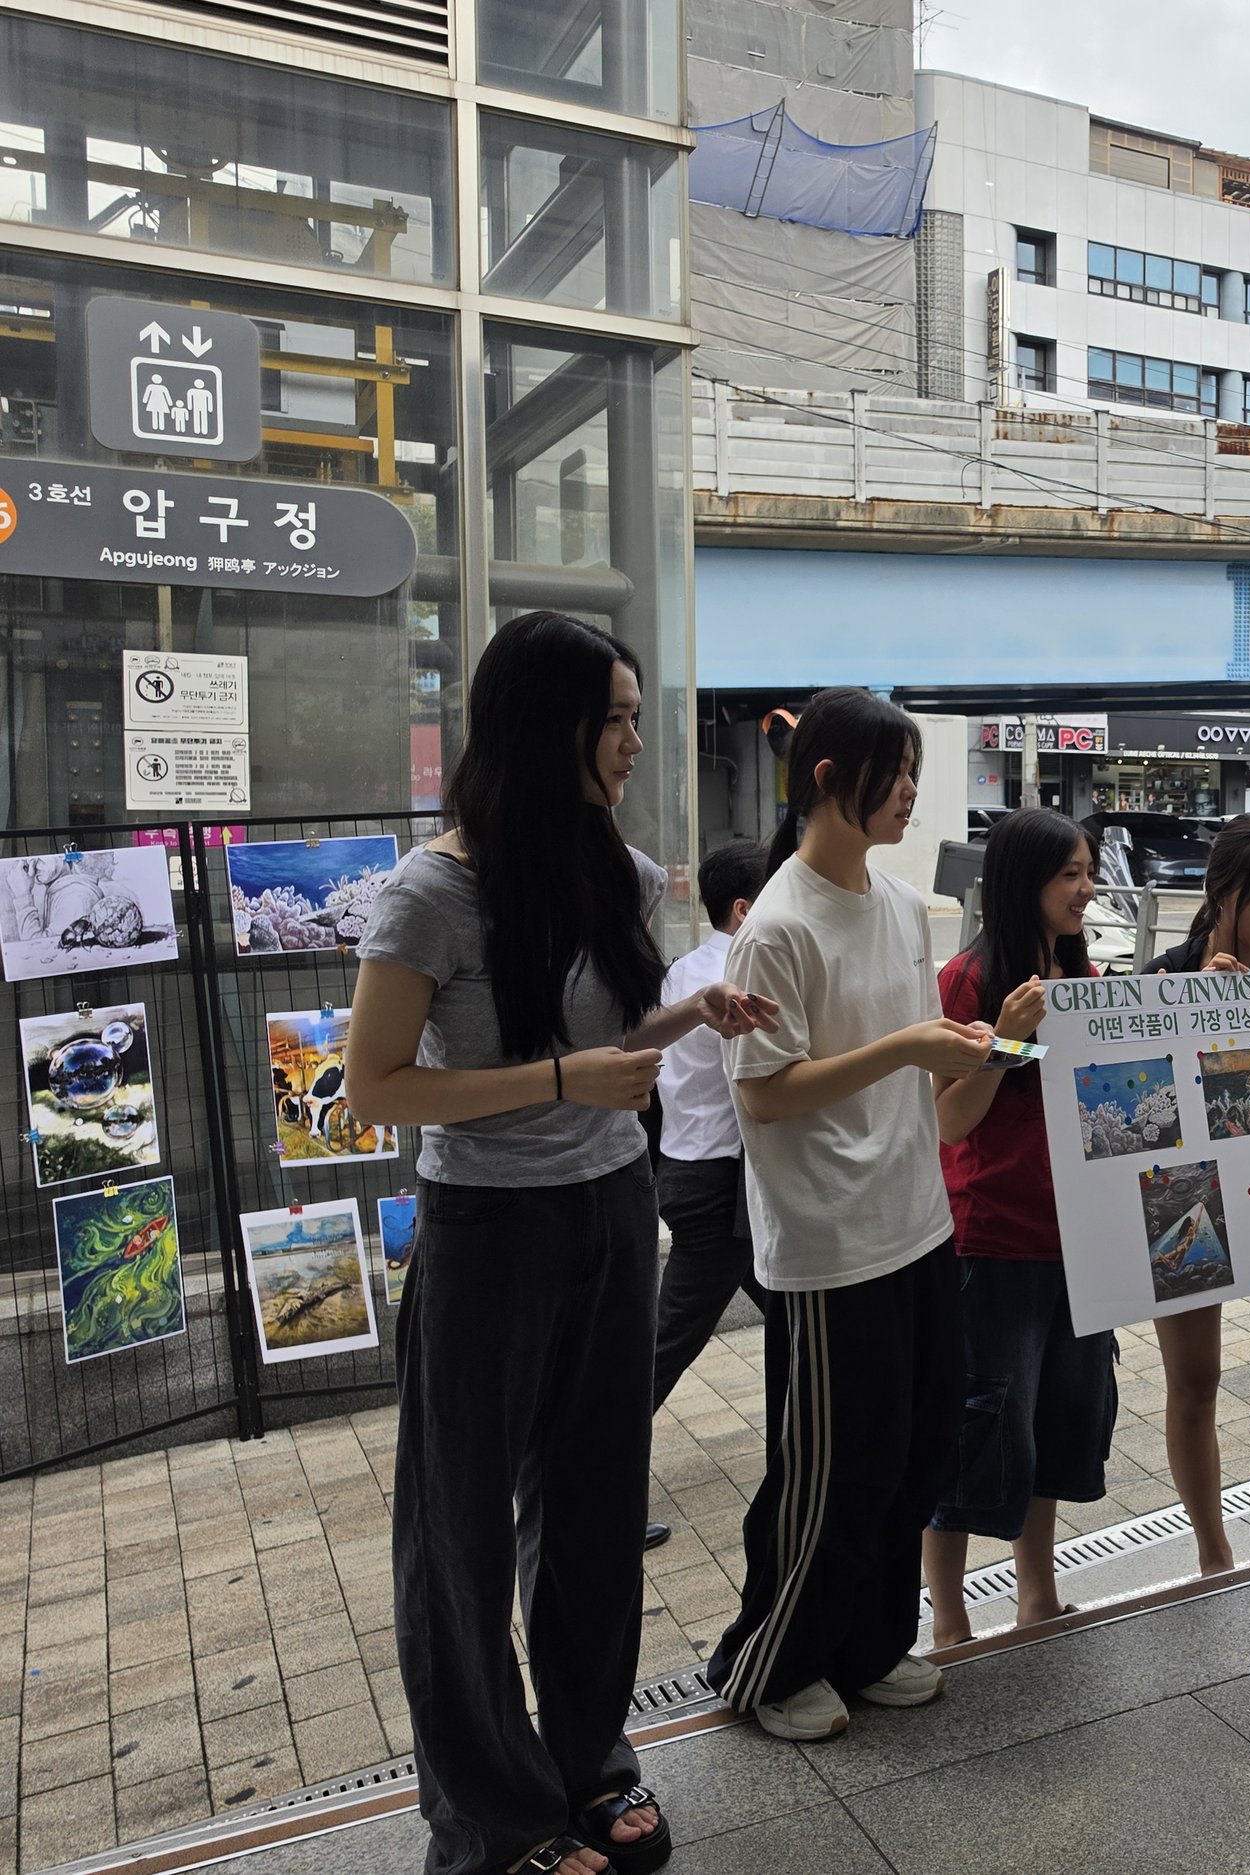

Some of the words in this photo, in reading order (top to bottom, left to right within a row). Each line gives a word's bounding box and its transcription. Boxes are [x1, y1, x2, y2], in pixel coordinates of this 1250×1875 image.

[28, 482, 92, 507] 3호선
[122, 488, 317, 551] 압구정
[99, 547, 197, 572] Apgujeong
[263, 562, 341, 580] アックジョン
[180, 690, 216, 701] 무단투기
[219, 691, 237, 702] 금지
[209, 680, 237, 690] 쓰레기
[981, 726, 999, 747] PC
[1058, 727, 1094, 750] PC
[1050, 978, 1143, 1012] GREEN
[1088, 1017, 1124, 1041] 어떤
[1128, 1011, 1179, 1037] 작품이
[1190, 1008, 1222, 1032] 가장
